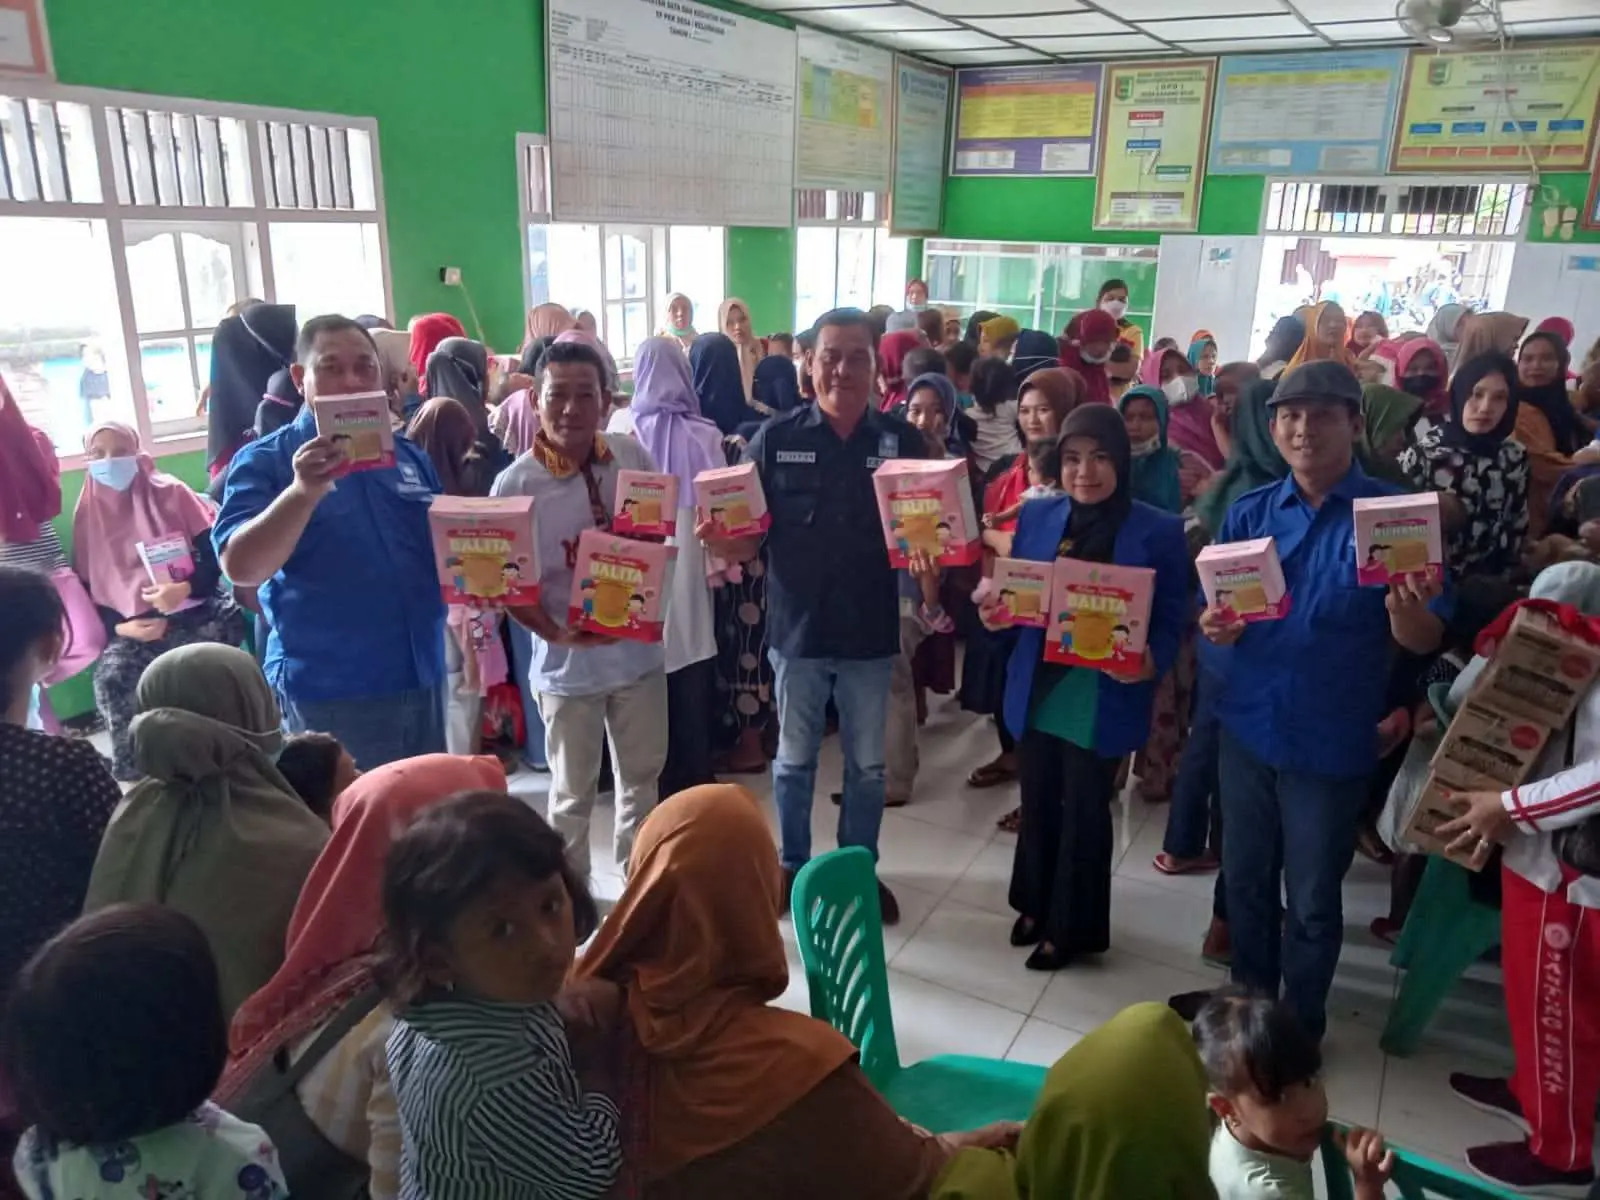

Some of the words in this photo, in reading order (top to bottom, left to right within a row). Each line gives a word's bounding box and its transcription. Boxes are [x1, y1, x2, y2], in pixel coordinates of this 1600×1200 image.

[450, 538, 512, 553] BALITA
[590, 562, 644, 585] BALITA
[1066, 592, 1128, 616] BALITA
